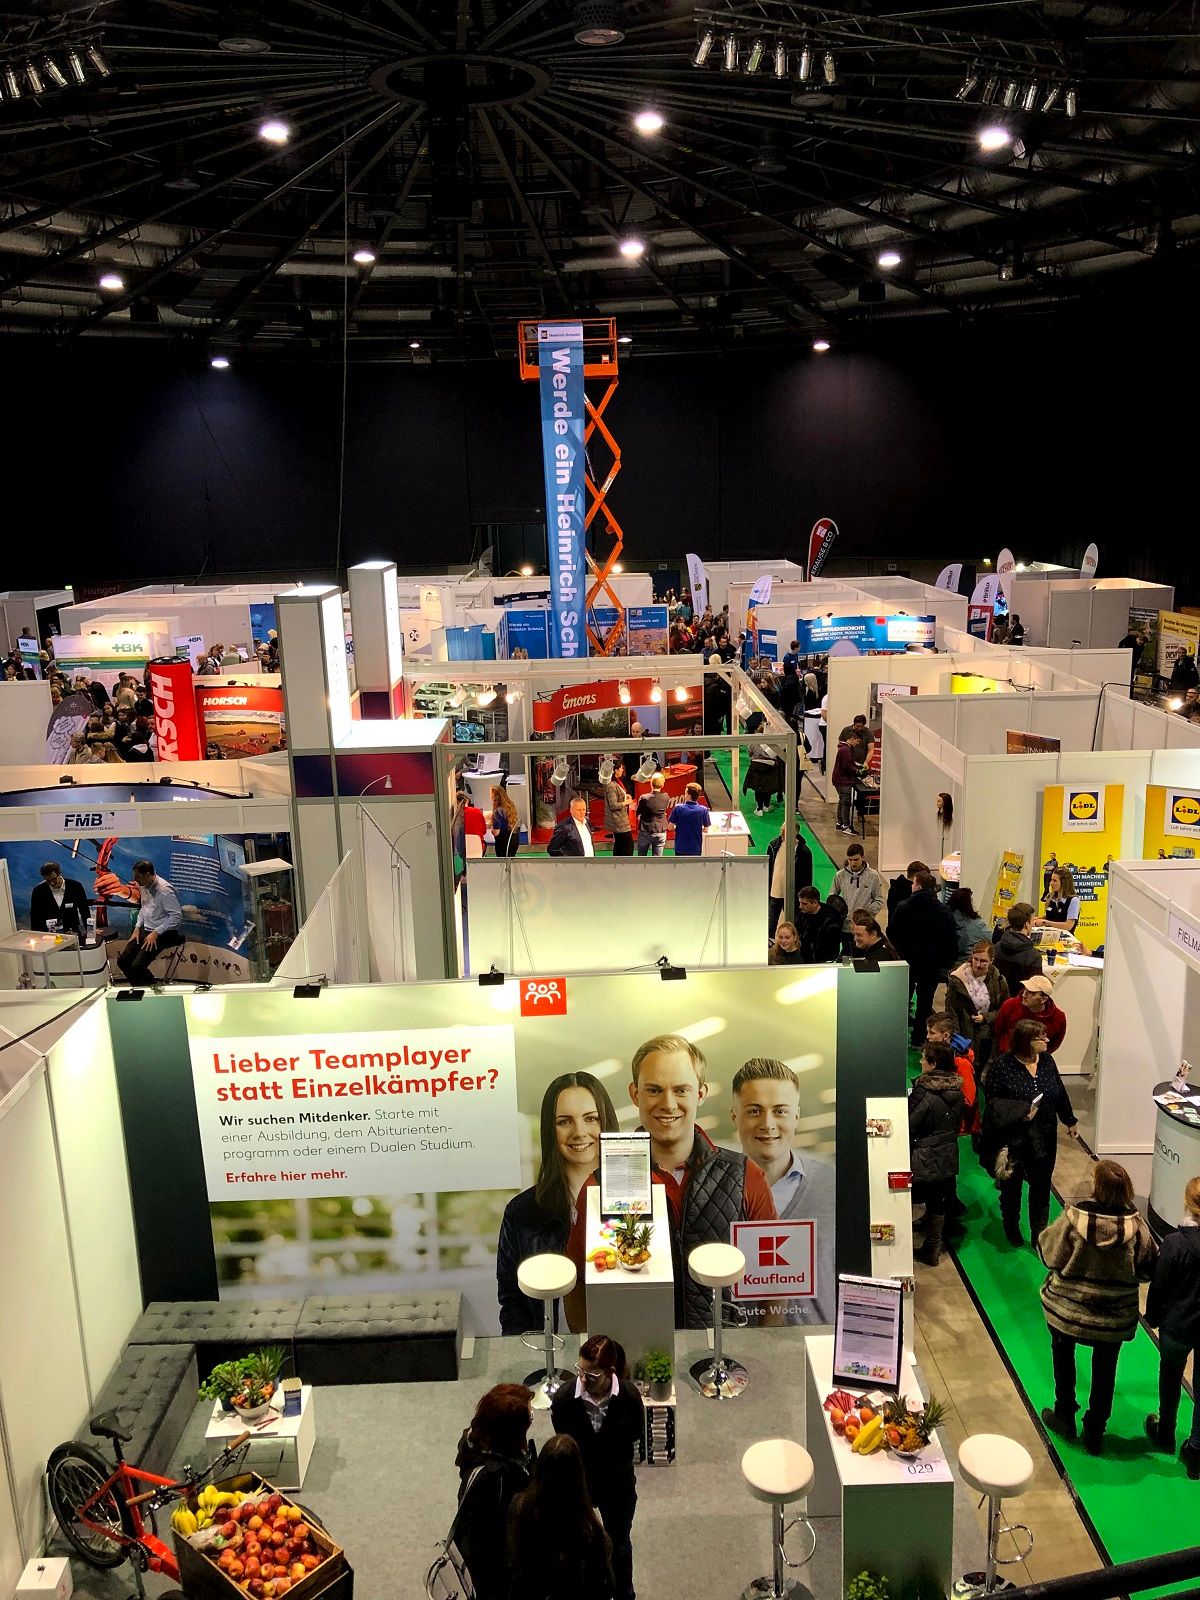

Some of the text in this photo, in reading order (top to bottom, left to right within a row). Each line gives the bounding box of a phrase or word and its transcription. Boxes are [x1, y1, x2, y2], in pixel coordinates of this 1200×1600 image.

[552, 348, 572, 435] Werde
[555, 443, 574, 484] ein
[556, 494, 577, 602] Heinrich
[811, 548, 826, 575] KRAUSE
[826, 531, 833, 541] CO
[203, 696, 248, 706] HORSCH
[562, 693, 597, 710] Emons
[64, 813, 103, 827] FMB
[212, 1046, 471, 1074] Lieber Teamplayer
[217, 1068, 499, 1101] statt Einzelkämpfer?
[219, 1107, 440, 1126] Wir suchen Mitdenker. Starte mit
[221, 1123, 453, 1143] einer Ausbildung, dem Abiturienten-
[223, 1138, 475, 1161] programm oder einem Dualen Studium.
[225, 1168, 348, 1183] Erfahre hier mehr.
[743, 1272, 805, 1285] Kaufland
[738, 1304, 812, 1316] Gute Woche.
[907, 1463, 934, 1475] 029
